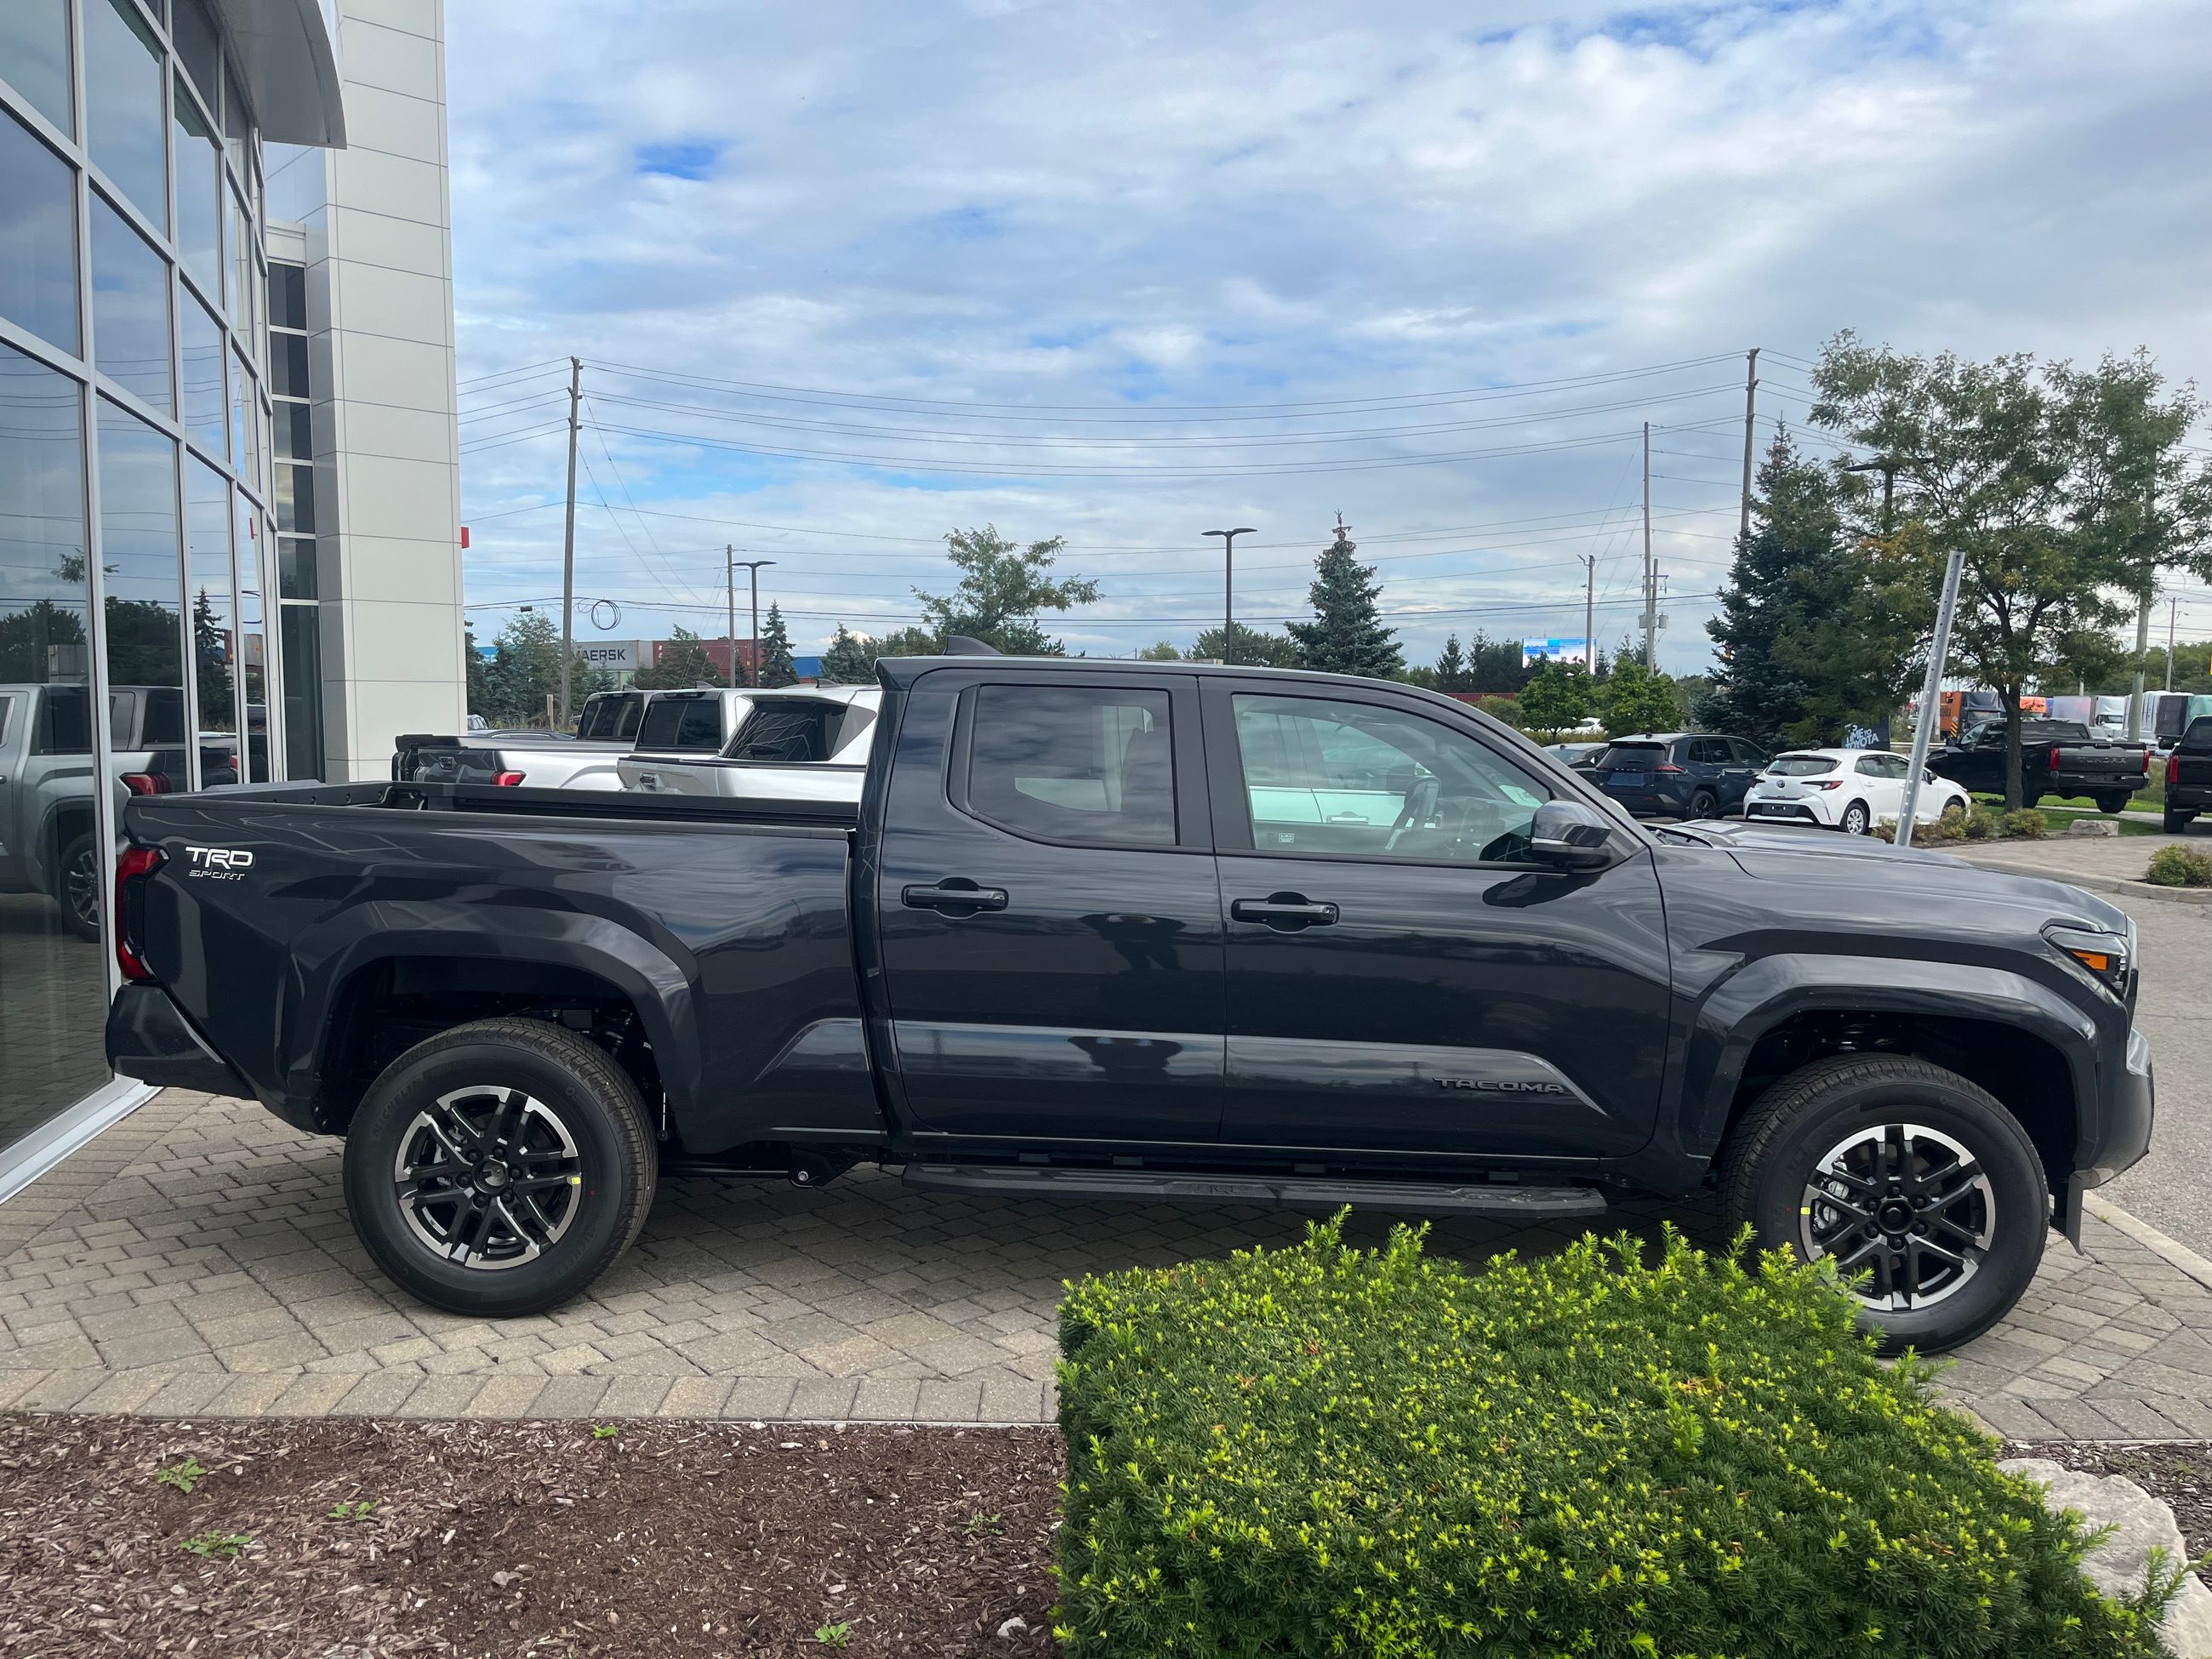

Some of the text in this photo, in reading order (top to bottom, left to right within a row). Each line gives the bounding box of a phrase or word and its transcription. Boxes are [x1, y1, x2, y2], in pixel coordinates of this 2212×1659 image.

[1844, 733, 1879, 749] TOYOTA
[185, 847, 254, 869] TRD
[188, 869, 245, 881] SPORT
[1432, 1078, 1565, 1093] TACOMA
